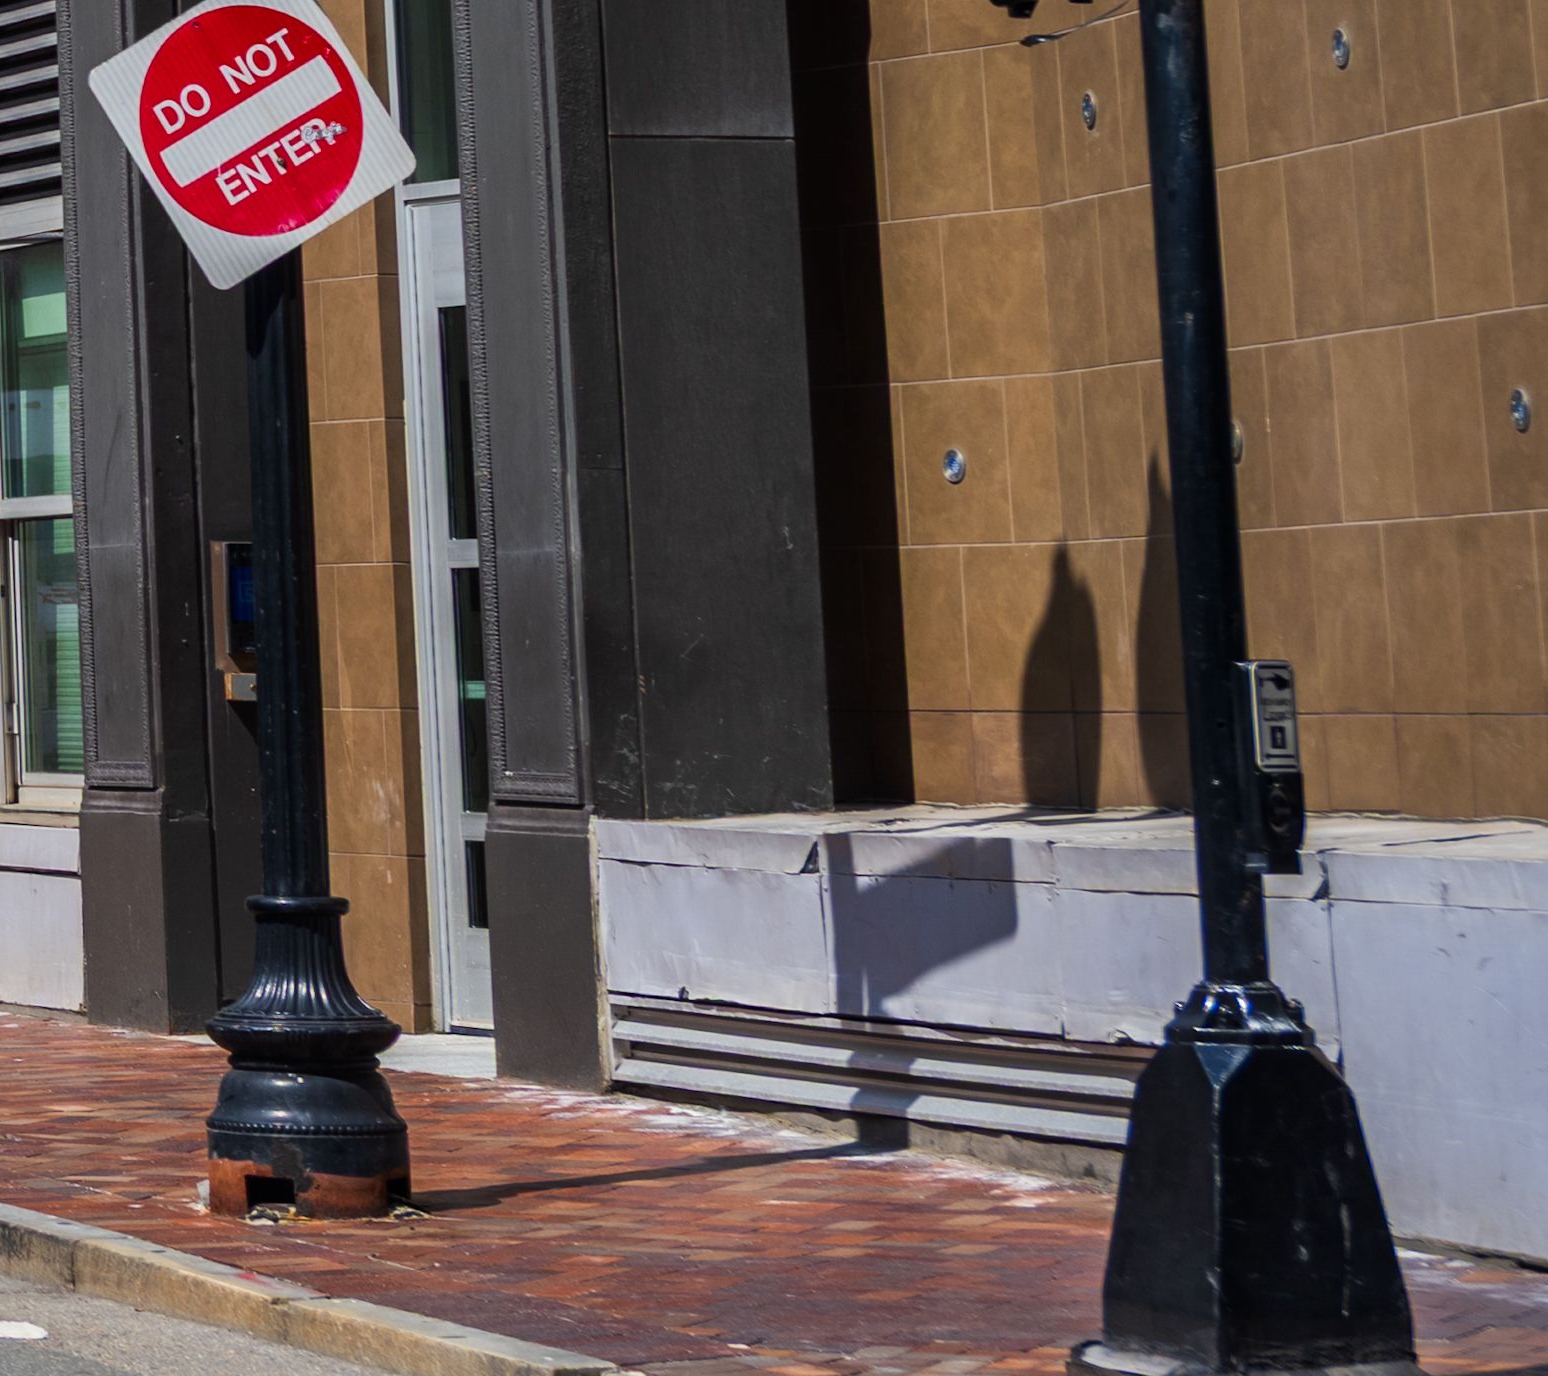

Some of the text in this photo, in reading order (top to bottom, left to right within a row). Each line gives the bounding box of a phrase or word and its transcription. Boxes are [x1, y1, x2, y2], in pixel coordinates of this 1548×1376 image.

[152, 28, 295, 134] DO NOT
[215, 118, 336, 206] ENTER
